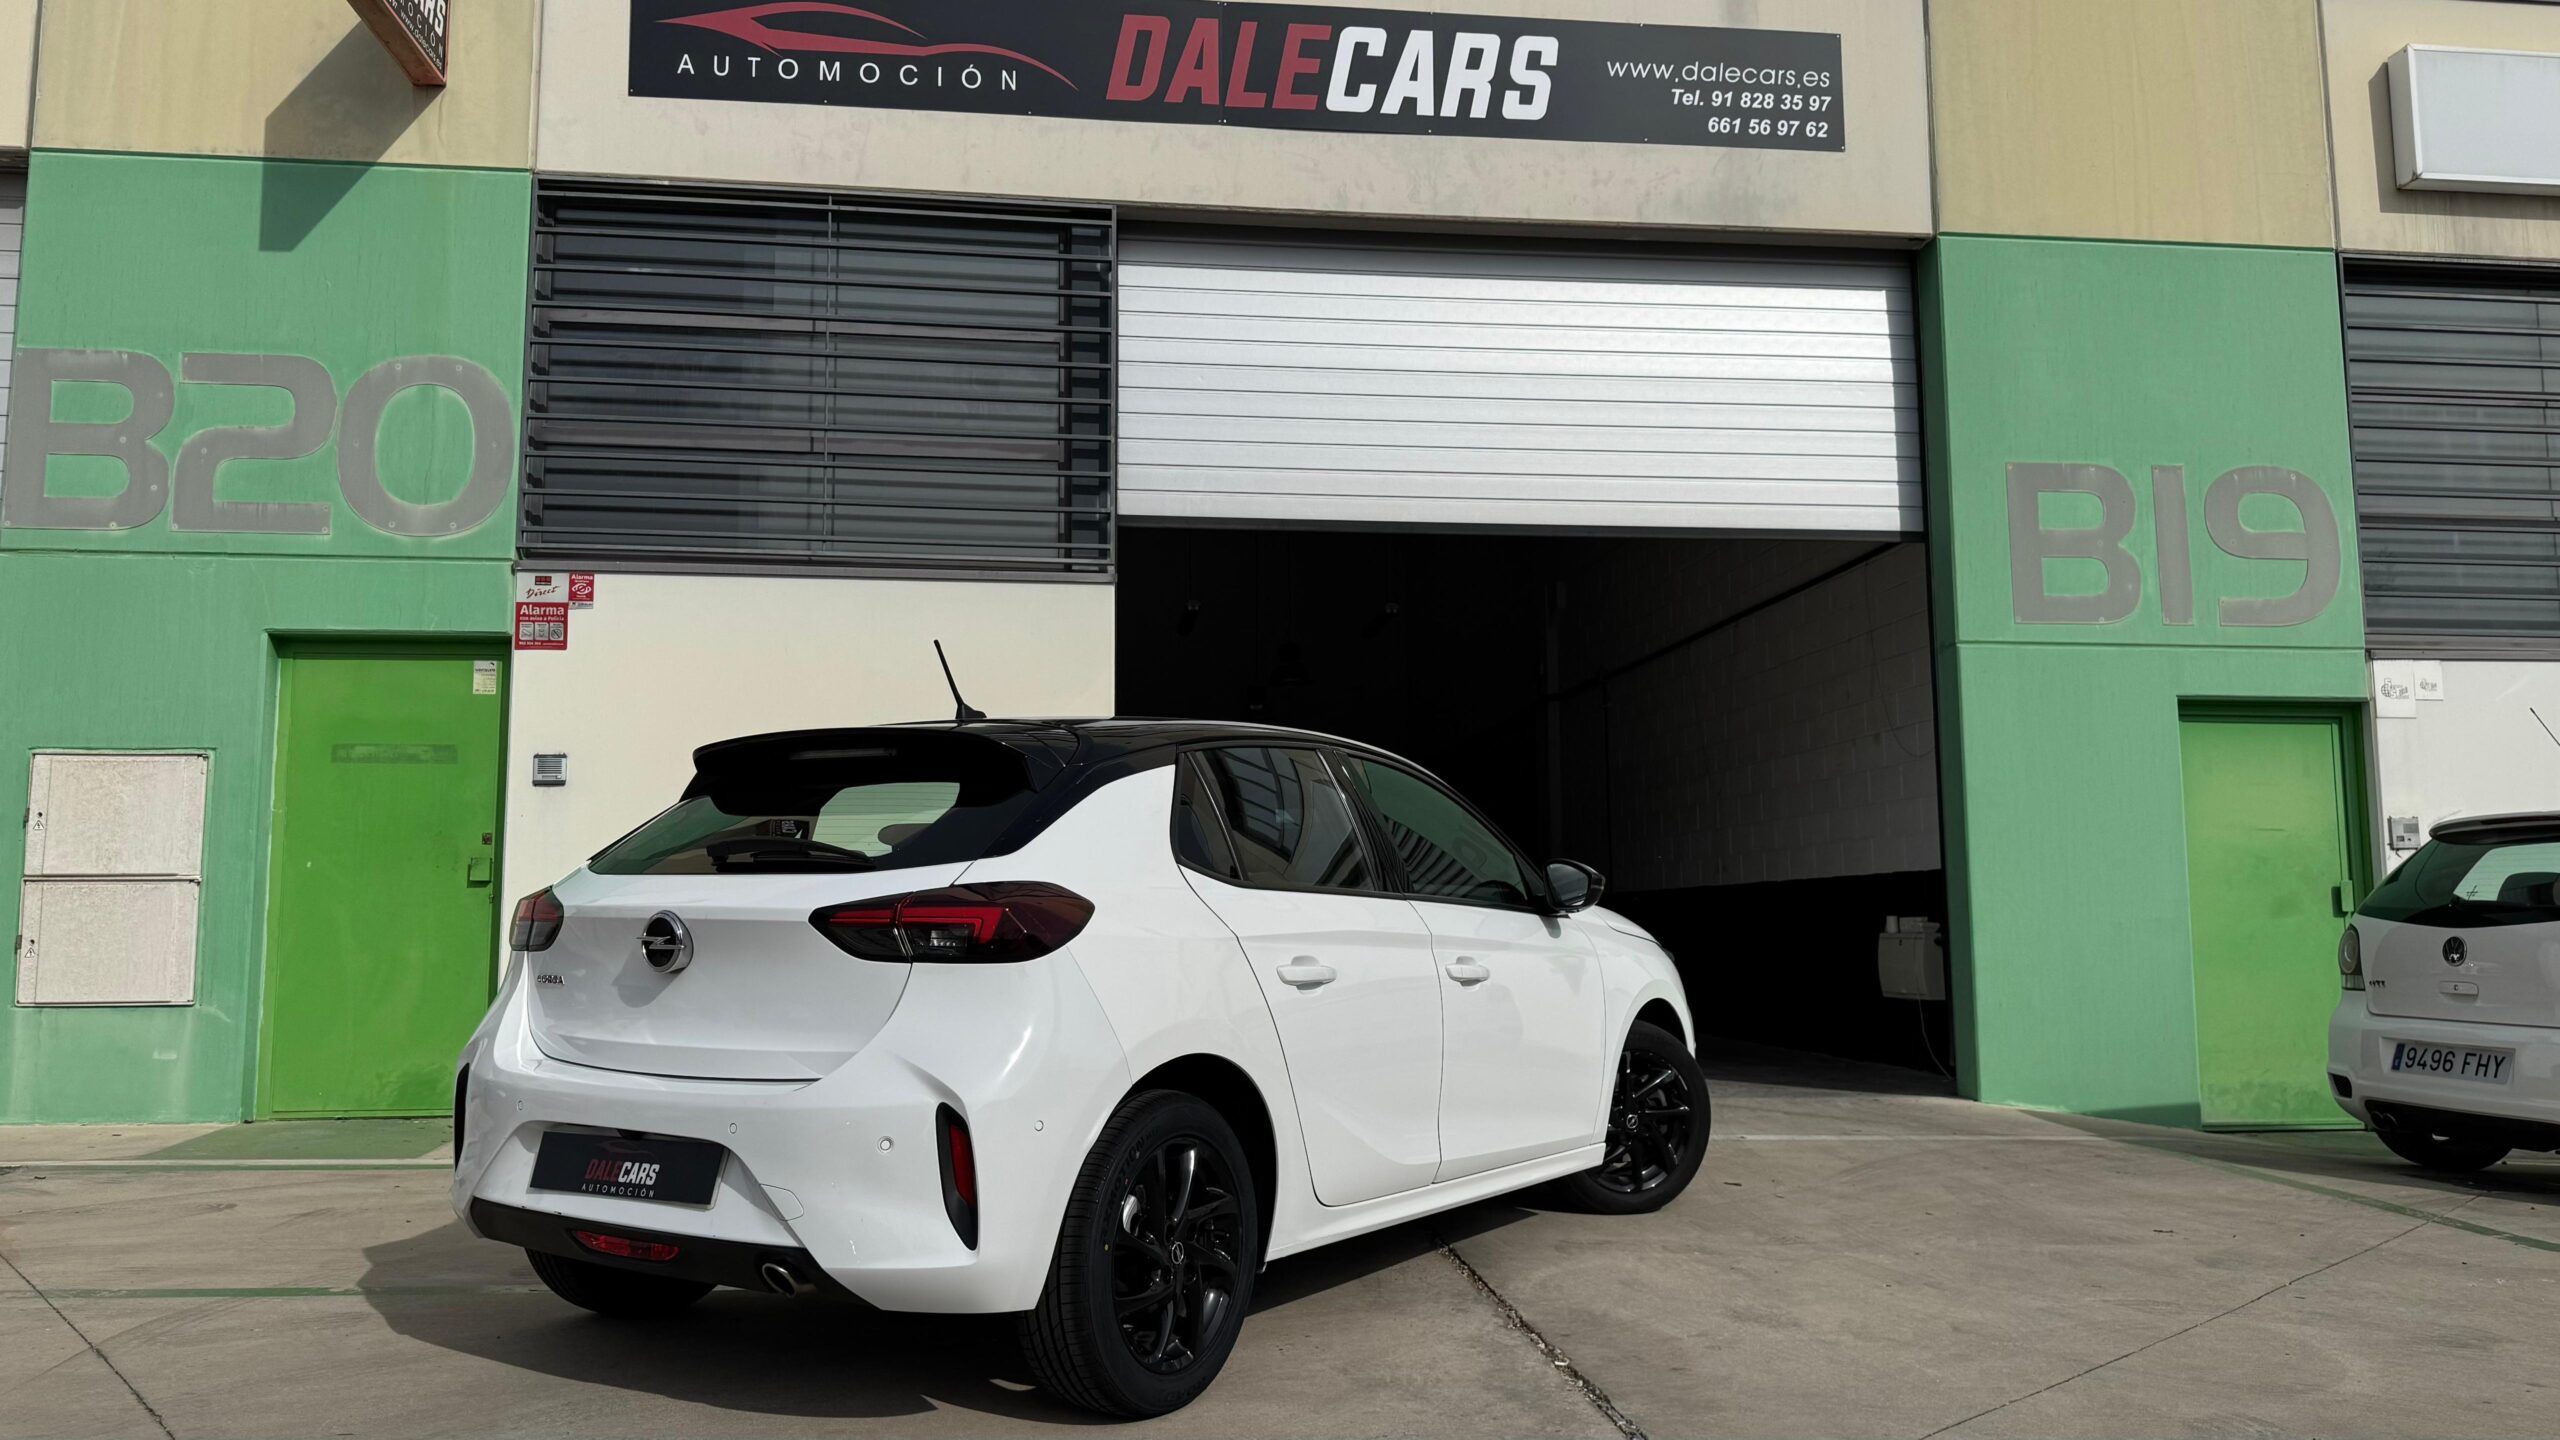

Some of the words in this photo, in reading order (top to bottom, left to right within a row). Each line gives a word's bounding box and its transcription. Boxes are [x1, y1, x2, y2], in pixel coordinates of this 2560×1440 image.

[677, 53, 1018, 91] AUTOMOCIÓN
[1105, 13, 1559, 120] DALECARS
[1606, 61, 1831, 89] www.dalecars.es
[1671, 89, 1704, 106] Tel.
[1711, 90, 1734, 107] 91
[1740, 92, 1775, 109] 828
[1780, 94, 1803, 111] 35
[1809, 96, 1832, 112] 97
[1707, 117, 1741, 134] 661
[1748, 119, 1771, 135] 56
[1777, 120, 1799, 136] 97
[1805, 122, 1829, 138] 62
[3, 347, 515, 537] B20
[2005, 462, 2342, 627] B19
[520, 604, 565, 615] Alarma
[2404, 1047, 2456, 1073] 9496
[2460, 1053, 2506, 1079] FHY
[584, 1159, 660, 1185] DALECARS
[581, 1183, 655, 1198] AUTOMOCIÓN
